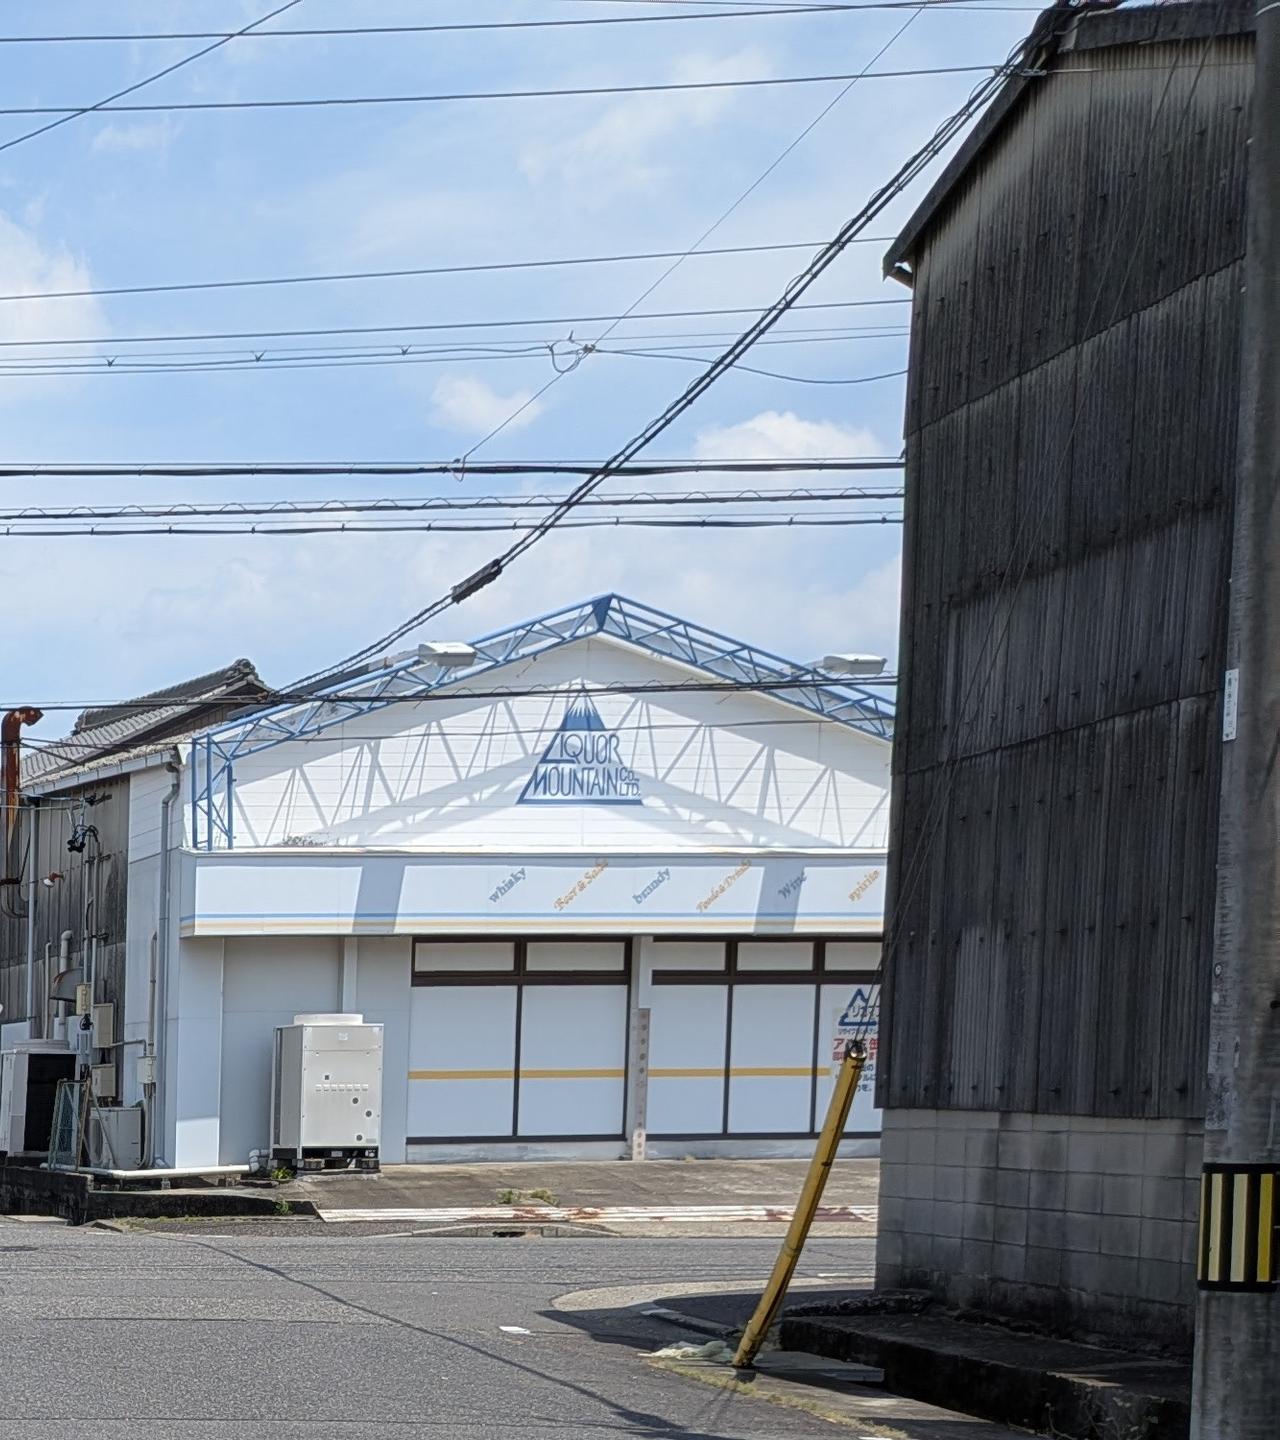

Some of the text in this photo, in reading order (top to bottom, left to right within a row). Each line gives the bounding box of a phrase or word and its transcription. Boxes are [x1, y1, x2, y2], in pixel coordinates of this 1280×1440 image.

[539, 732, 624, 764] LIQUOR
[520, 767, 619, 796] MOUNTAIN
[489, 868, 527, 903] whisky
[632, 867, 670, 905] brandy
